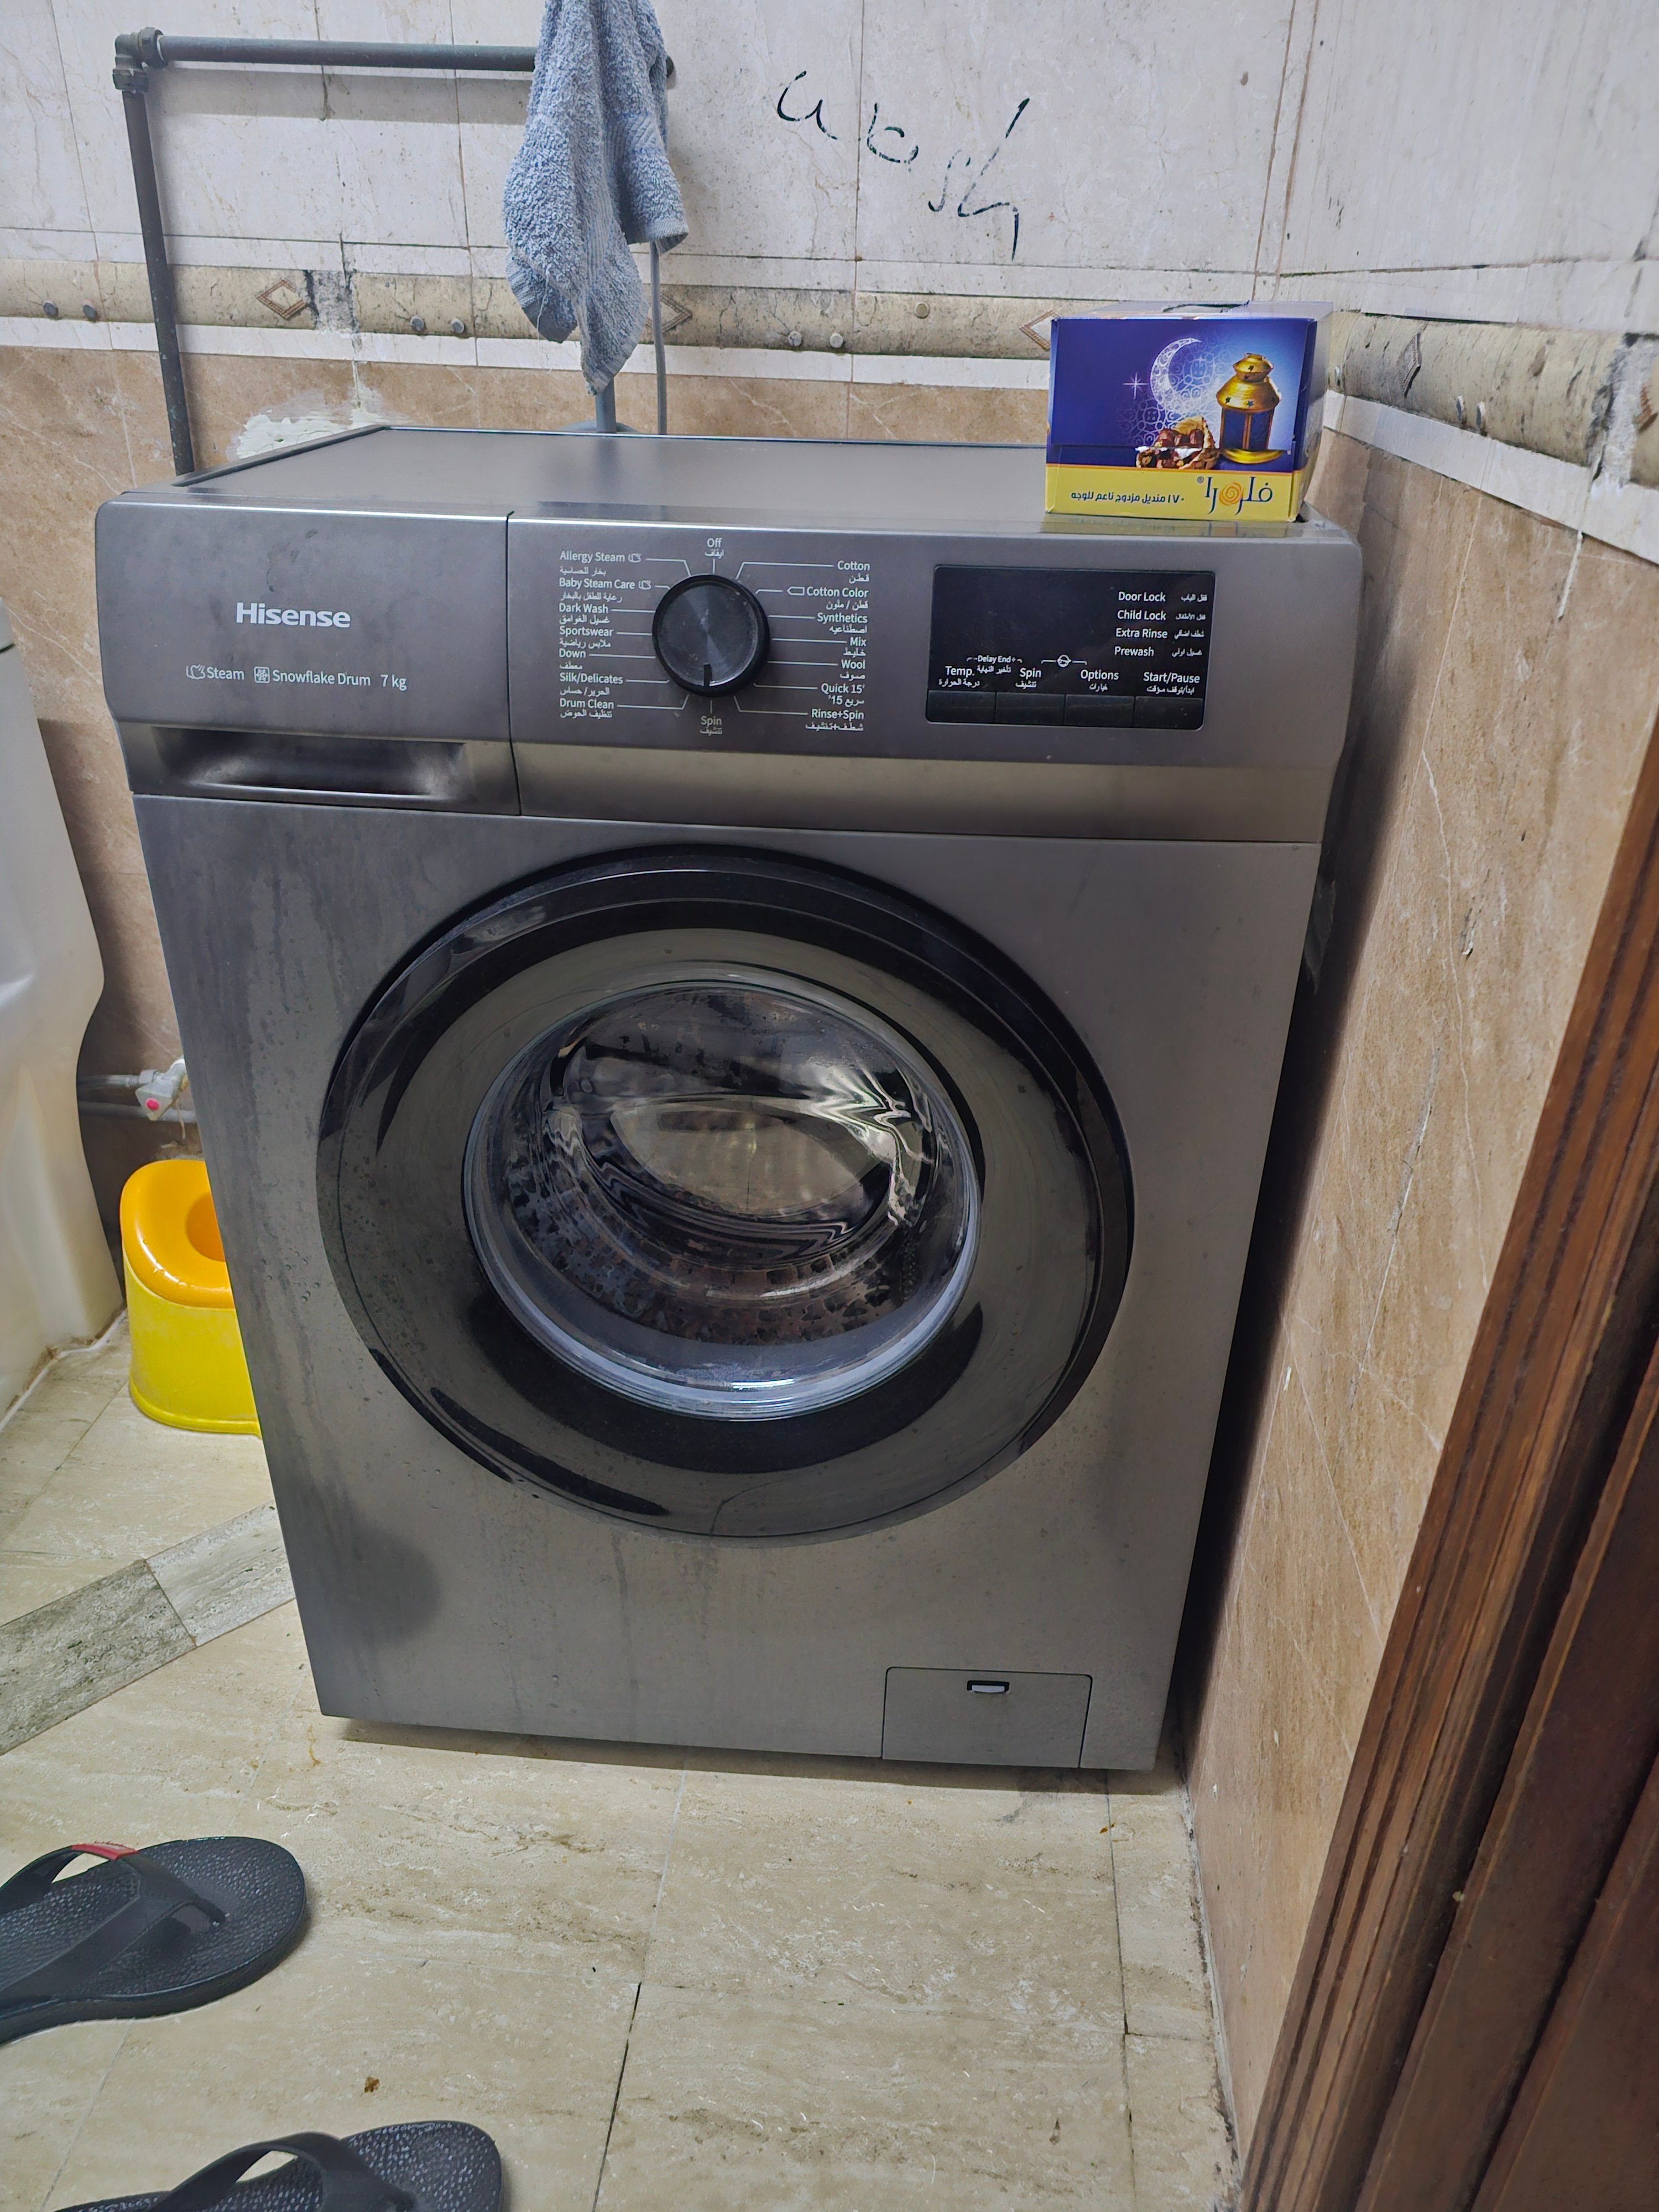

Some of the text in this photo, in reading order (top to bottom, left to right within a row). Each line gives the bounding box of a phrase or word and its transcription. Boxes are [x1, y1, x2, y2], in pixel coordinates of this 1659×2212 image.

[1071, 492, 1094, 500] للوجه
[1095, 492, 1114, 501] ناعم
[1115, 493, 1140, 503] مزدوج
[1142, 494, 1165, 504] منديل
[707, 538, 722, 547] Off
[560, 551, 625, 564] Allergy Steam
[838, 561, 870, 570] Cotton
[592, 568, 606, 576] بخار
[849, 573, 869, 583] قطن
[560, 578, 635, 589] Baby Steam Care
[807, 586, 869, 597] Cotton Color
[1119, 592, 1165, 602] Door Lock
[559, 603, 608, 613] Dark Wash
[852, 600, 868, 611] قطن
[237, 602, 350, 627] Hisense
[817, 612, 867, 624] Synthetics
[1118, 609, 1166, 620] Child Lock
[560, 615, 610, 625] غسيل الغوامق
[560, 625, 613, 637] Sportswear
[1116, 628, 1167, 638] Extra Rinse
[560, 638, 611, 649] ملابس رياضية
[850, 637, 867, 646] Mix
[559, 648, 586, 658] Down
[843, 648, 866, 658] خليط
[1115, 646, 1154, 656] Prewash
[841, 659, 865, 669] Wool
[978, 655, 997, 664] Delay
[207, 667, 244, 680] Steam
[840, 672, 865, 681] صوف
[945, 666, 974, 678] Temp.
[1020, 667, 1041, 680] Spin
[1081, 670, 1119, 681] Options
[273, 670, 406, 691] Snowflake Drum 7 kg
[560, 672, 623, 684] Silk/Delicates
[1144, 672, 1200, 684] Start/Pause
[821, 683, 848, 694] Quick
[560, 698, 614, 709] Drum Clean
[845, 699, 864, 707] سريع
[560, 709, 612, 719] تنظيف الحوض
[812, 709, 864, 722] Rinse+Spin
[701, 716, 722, 727] Spin
